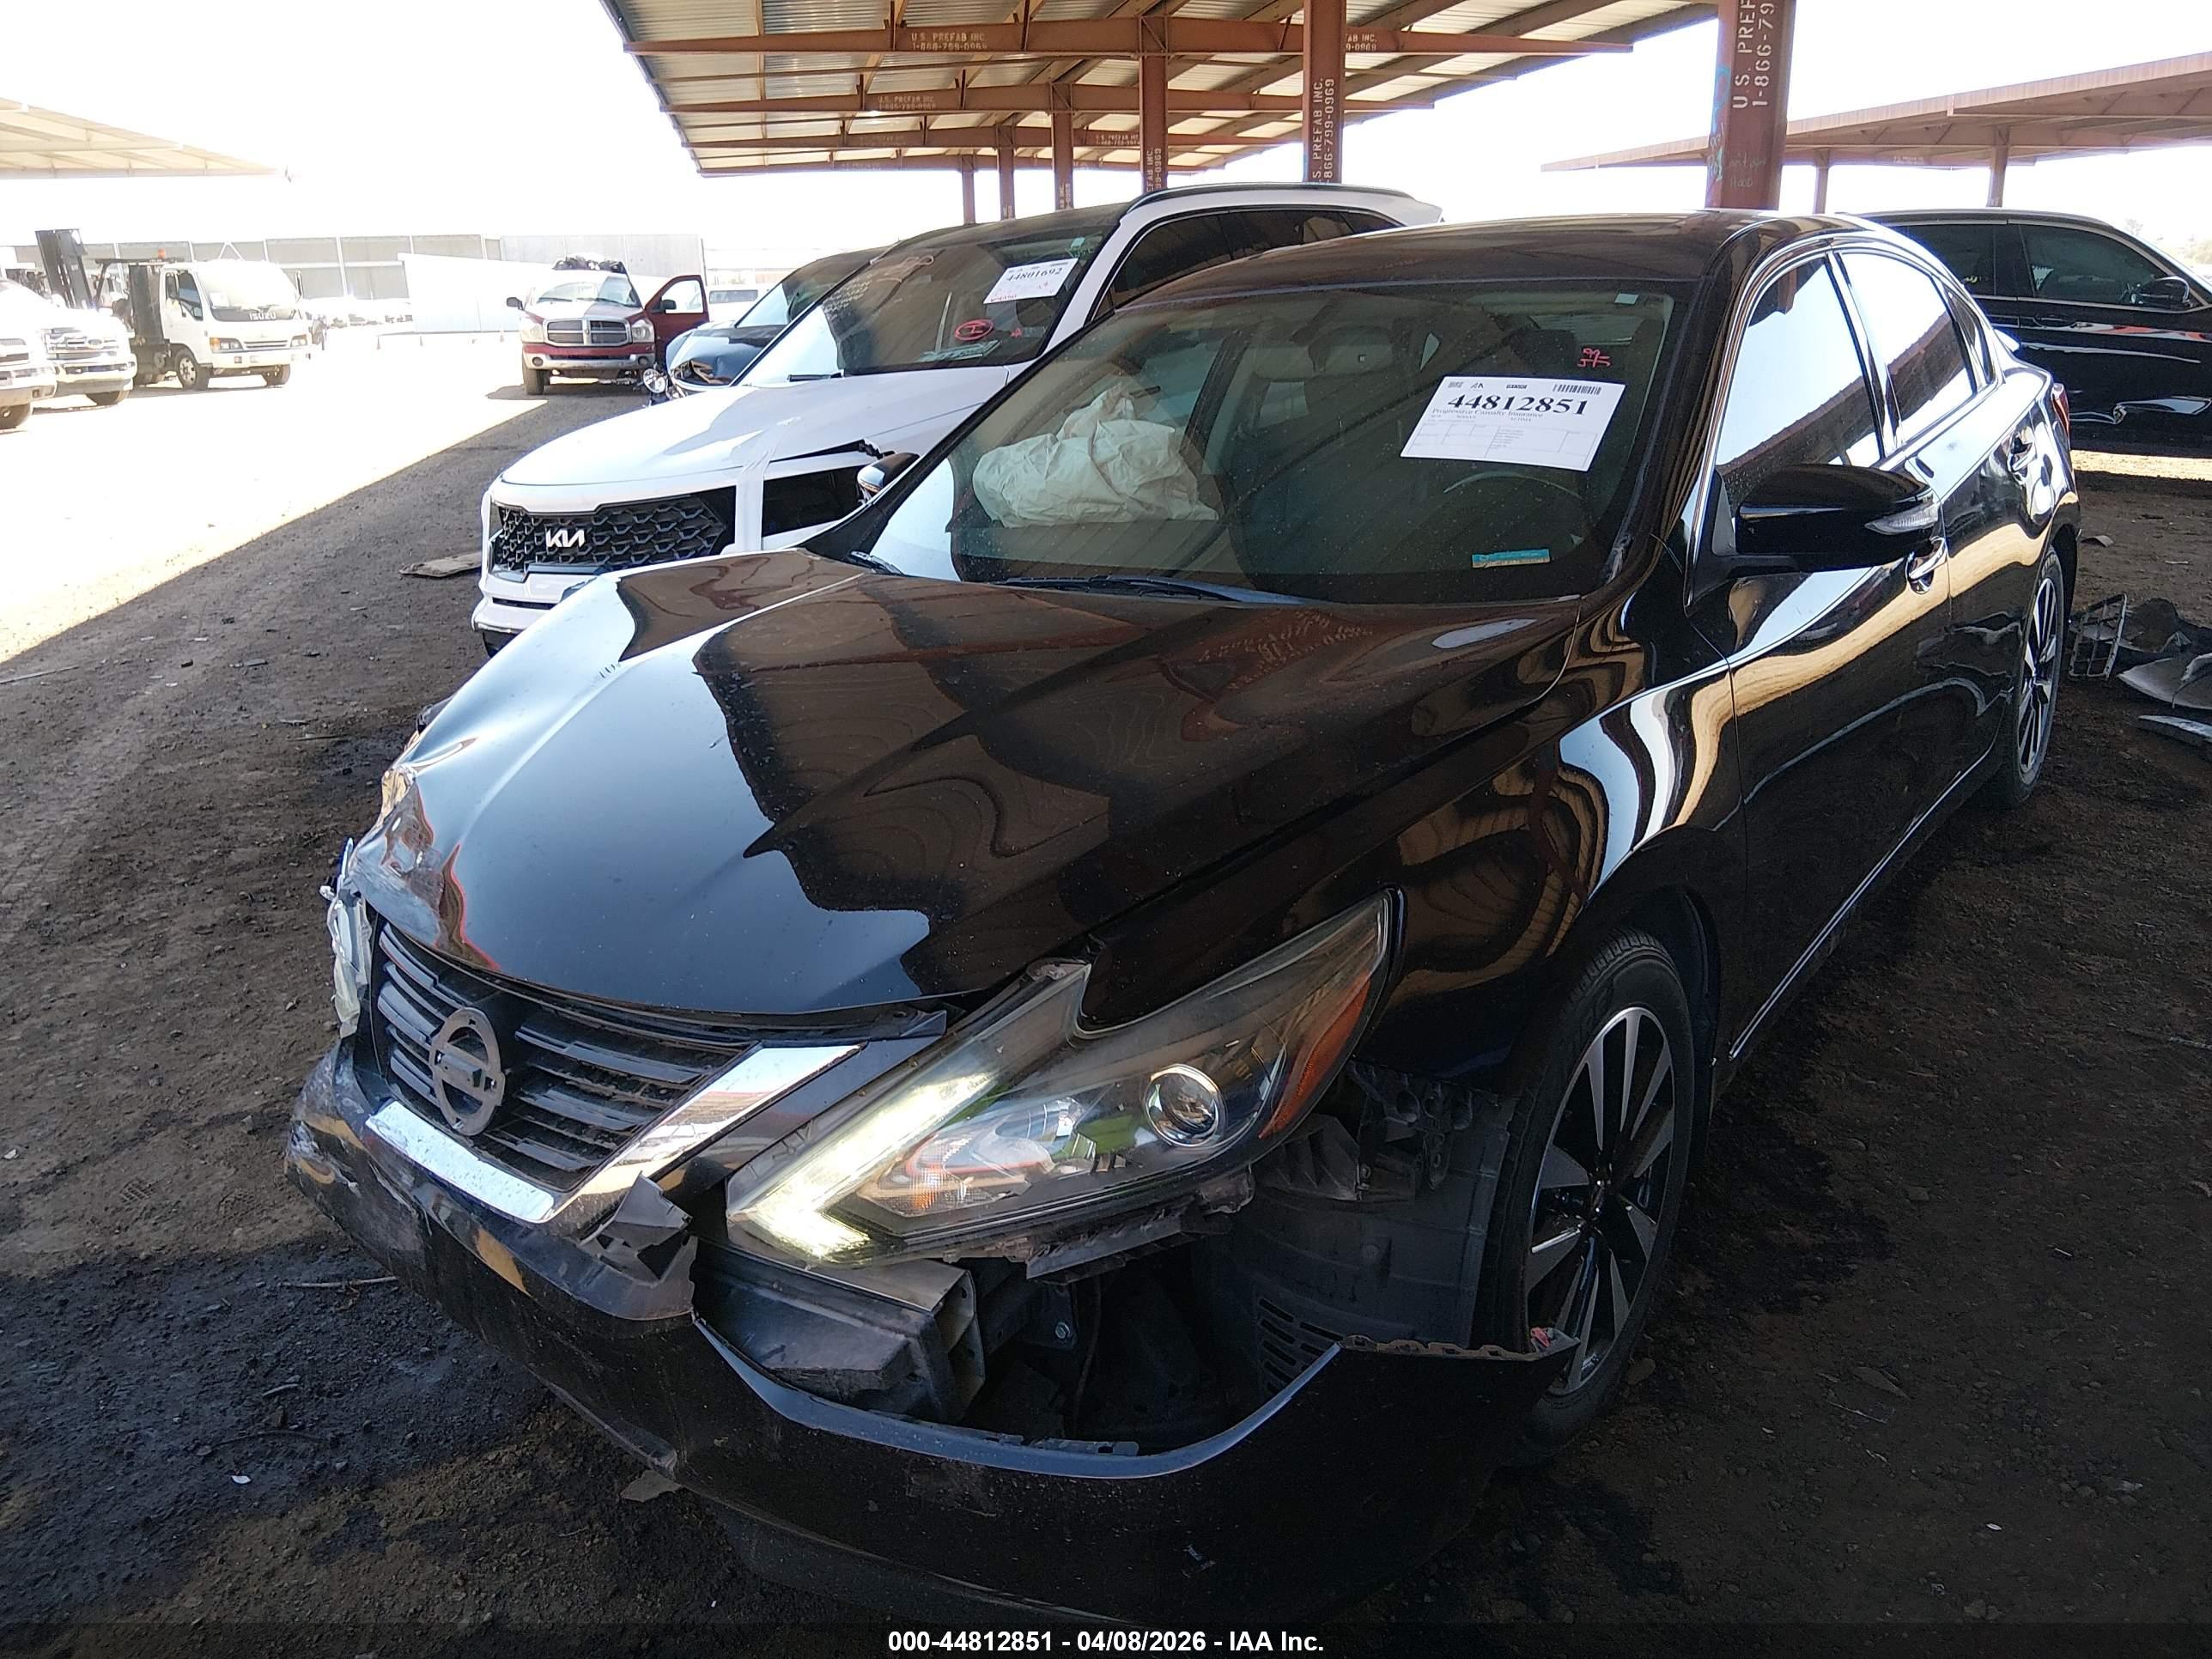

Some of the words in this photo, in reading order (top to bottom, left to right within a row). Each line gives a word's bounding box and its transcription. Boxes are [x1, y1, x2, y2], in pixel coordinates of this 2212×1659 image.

[933, 32, 967, 42] PREFAB
[1362, 33, 1377, 43] INC.
[1752, 3, 1775, 106] 1-866-79
[1313, 77, 1324, 103] INC.
[1312, 110, 1323, 160] PREFAB
[249, 311, 276, 320] ISUZU
[1447, 394, 1589, 416] 44812851
[545, 528, 586, 548] KIA
